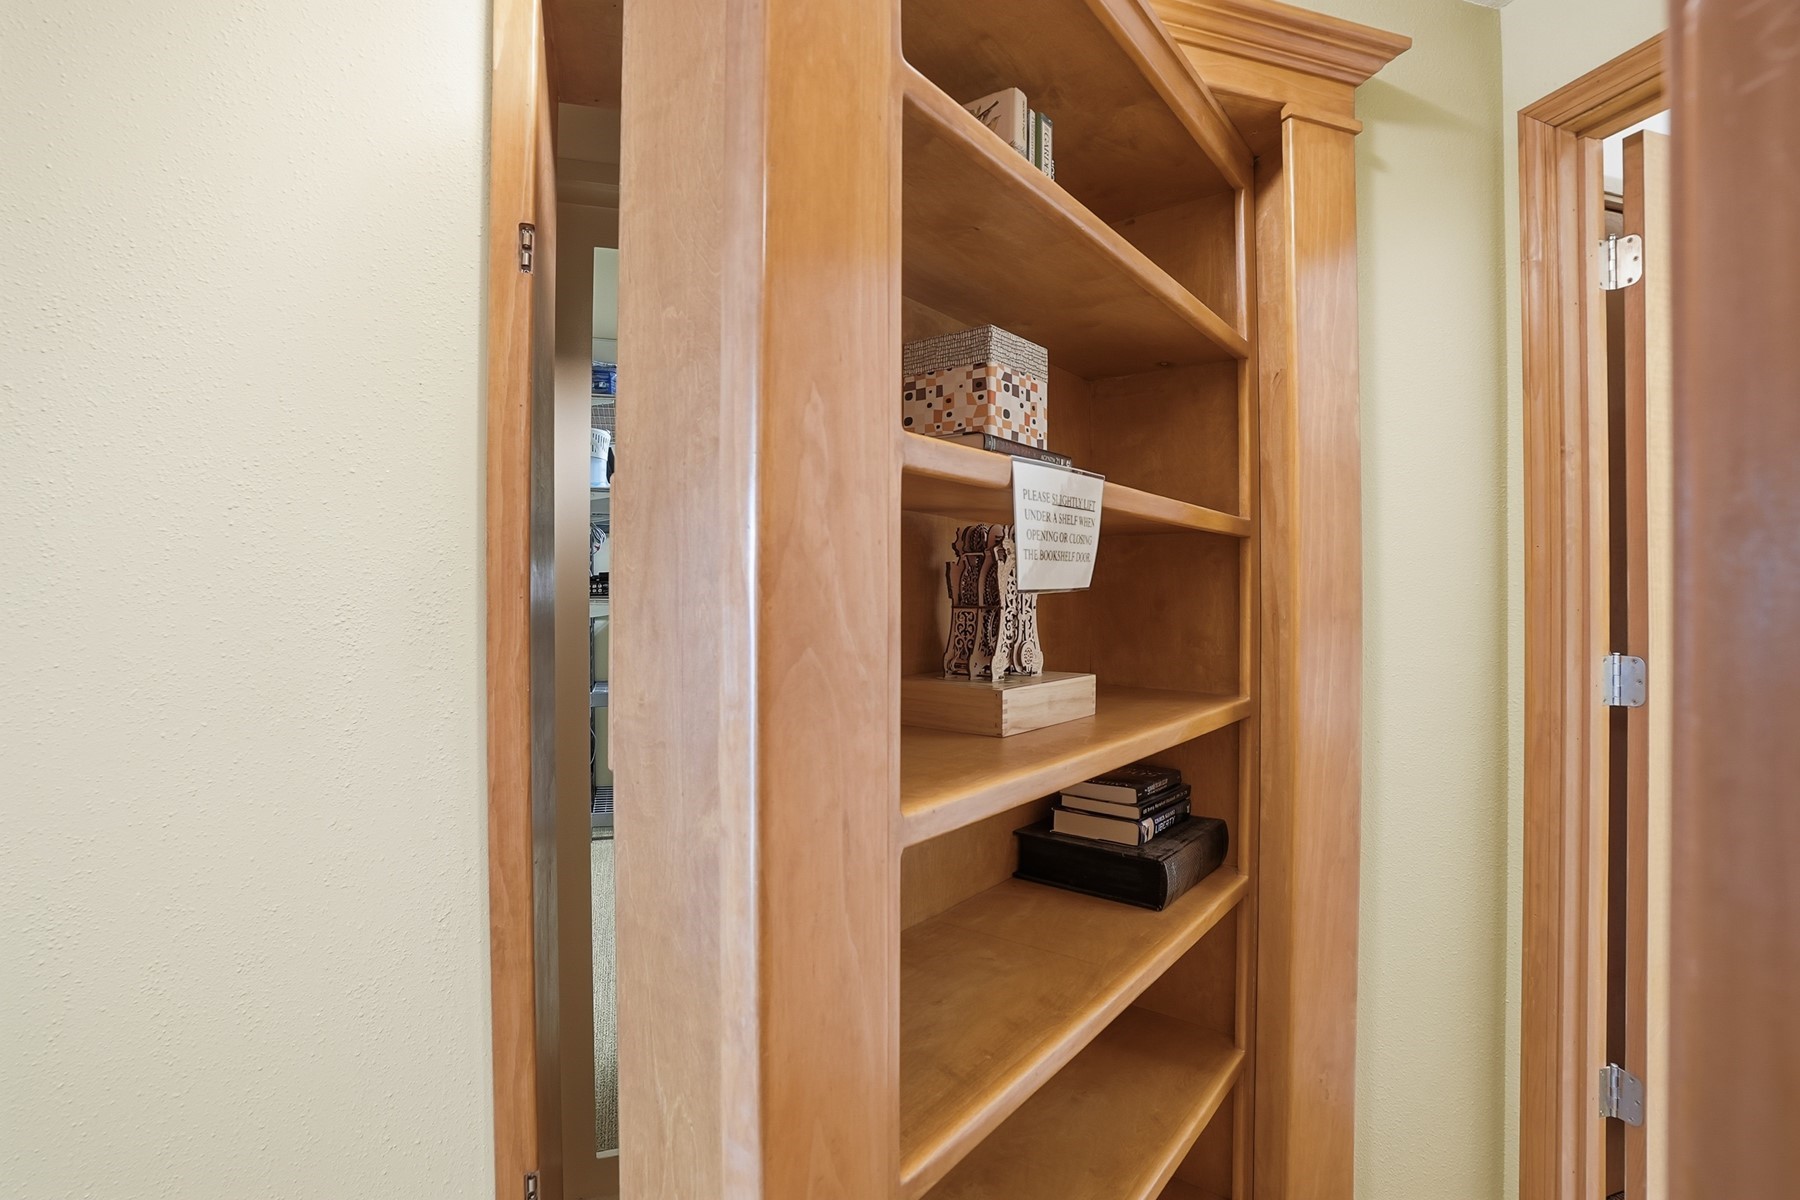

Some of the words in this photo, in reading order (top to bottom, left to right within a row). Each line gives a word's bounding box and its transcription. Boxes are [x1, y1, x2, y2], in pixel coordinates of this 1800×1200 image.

[1023, 488, 1050, 503] PLEASE
[1052, 493, 1082, 509] SLIGHTLY
[1083, 498, 1096, 511] LIFT
[1024, 508, 1051, 522] UNDER
[1053, 513, 1058, 523] A
[1058, 513, 1079, 526] SHELF
[1079, 517, 1096, 528] WHEN
[1026, 528, 1059, 543] OPENING
[1059, 532, 1068, 543] OR
[1069, 534, 1092, 545] CLOSING
[1023, 548, 1038, 561] THE
[1039, 549, 1076, 562] BOOKSHELF
